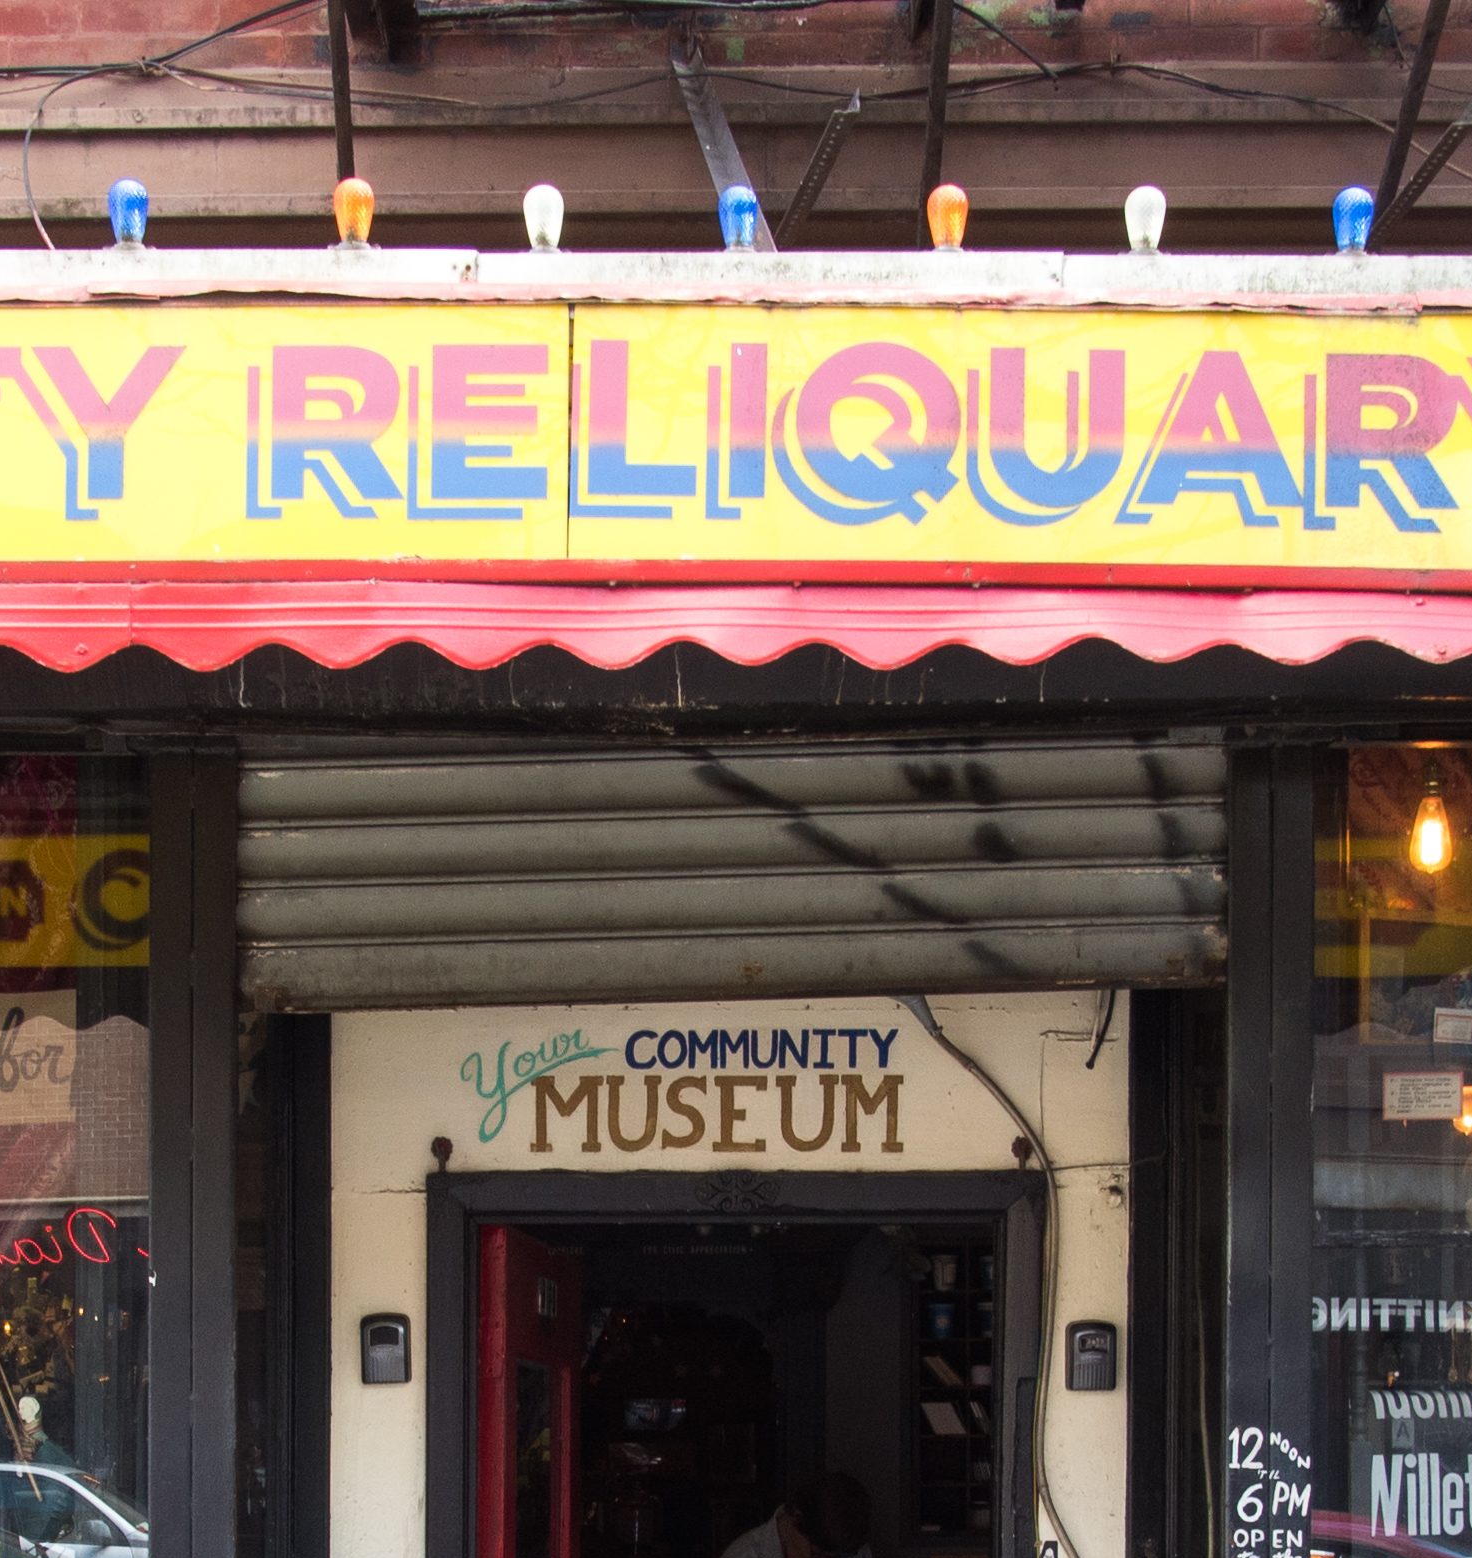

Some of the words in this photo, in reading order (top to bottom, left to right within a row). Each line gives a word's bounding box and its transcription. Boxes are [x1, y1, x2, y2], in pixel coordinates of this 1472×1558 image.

[460, 1029, 620, 1143] Your
[625, 1029, 899, 1070] COMMUNITY
[529, 1074, 905, 1153] MUSEUM
[1229, 1427, 1264, 1470] 12
[1270, 1431, 1310, 1469] NOON
[1237, 1483, 1263, 1522] 6
[1272, 1481, 1310, 1517] PM
[1234, 1529, 1303, 1549] OPEN
